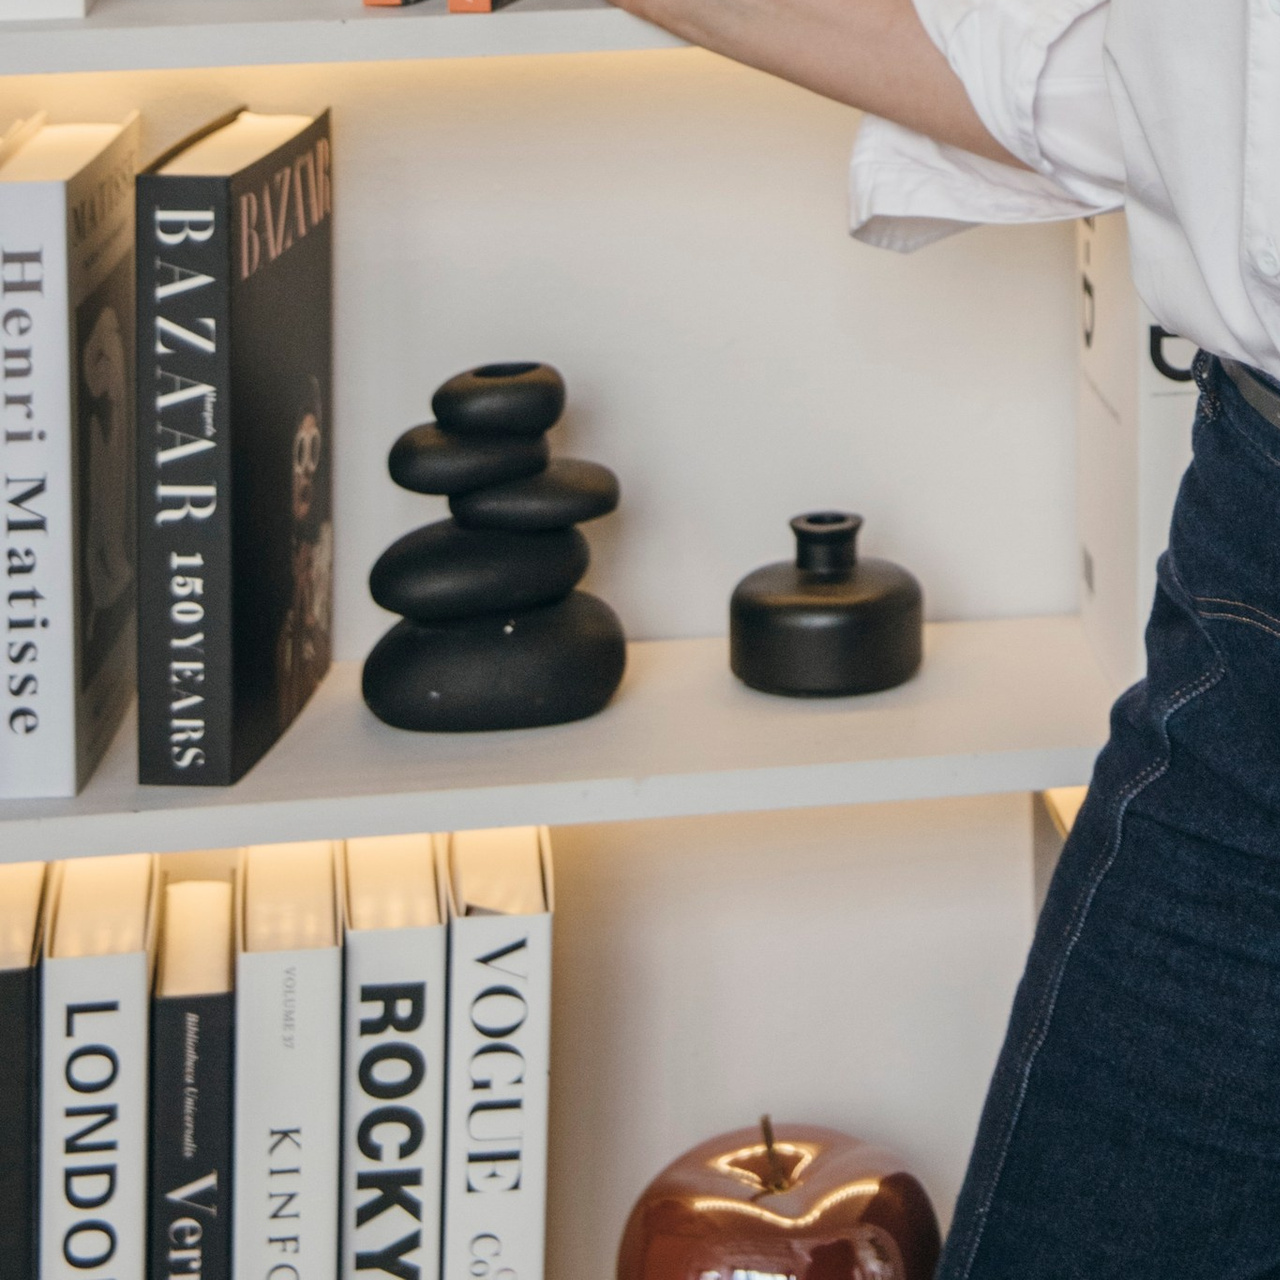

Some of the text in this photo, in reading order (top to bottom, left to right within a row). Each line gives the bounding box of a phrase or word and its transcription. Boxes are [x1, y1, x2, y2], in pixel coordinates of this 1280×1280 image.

[2, 248, 51, 737] Henri Matisse
[154, 206, 218, 526] BAZAAR
[61, 1000, 121, 1280] LONDO
[354, 980, 428, 1280] ROCKY
[466, 934, 530, 1195] VOGUE
